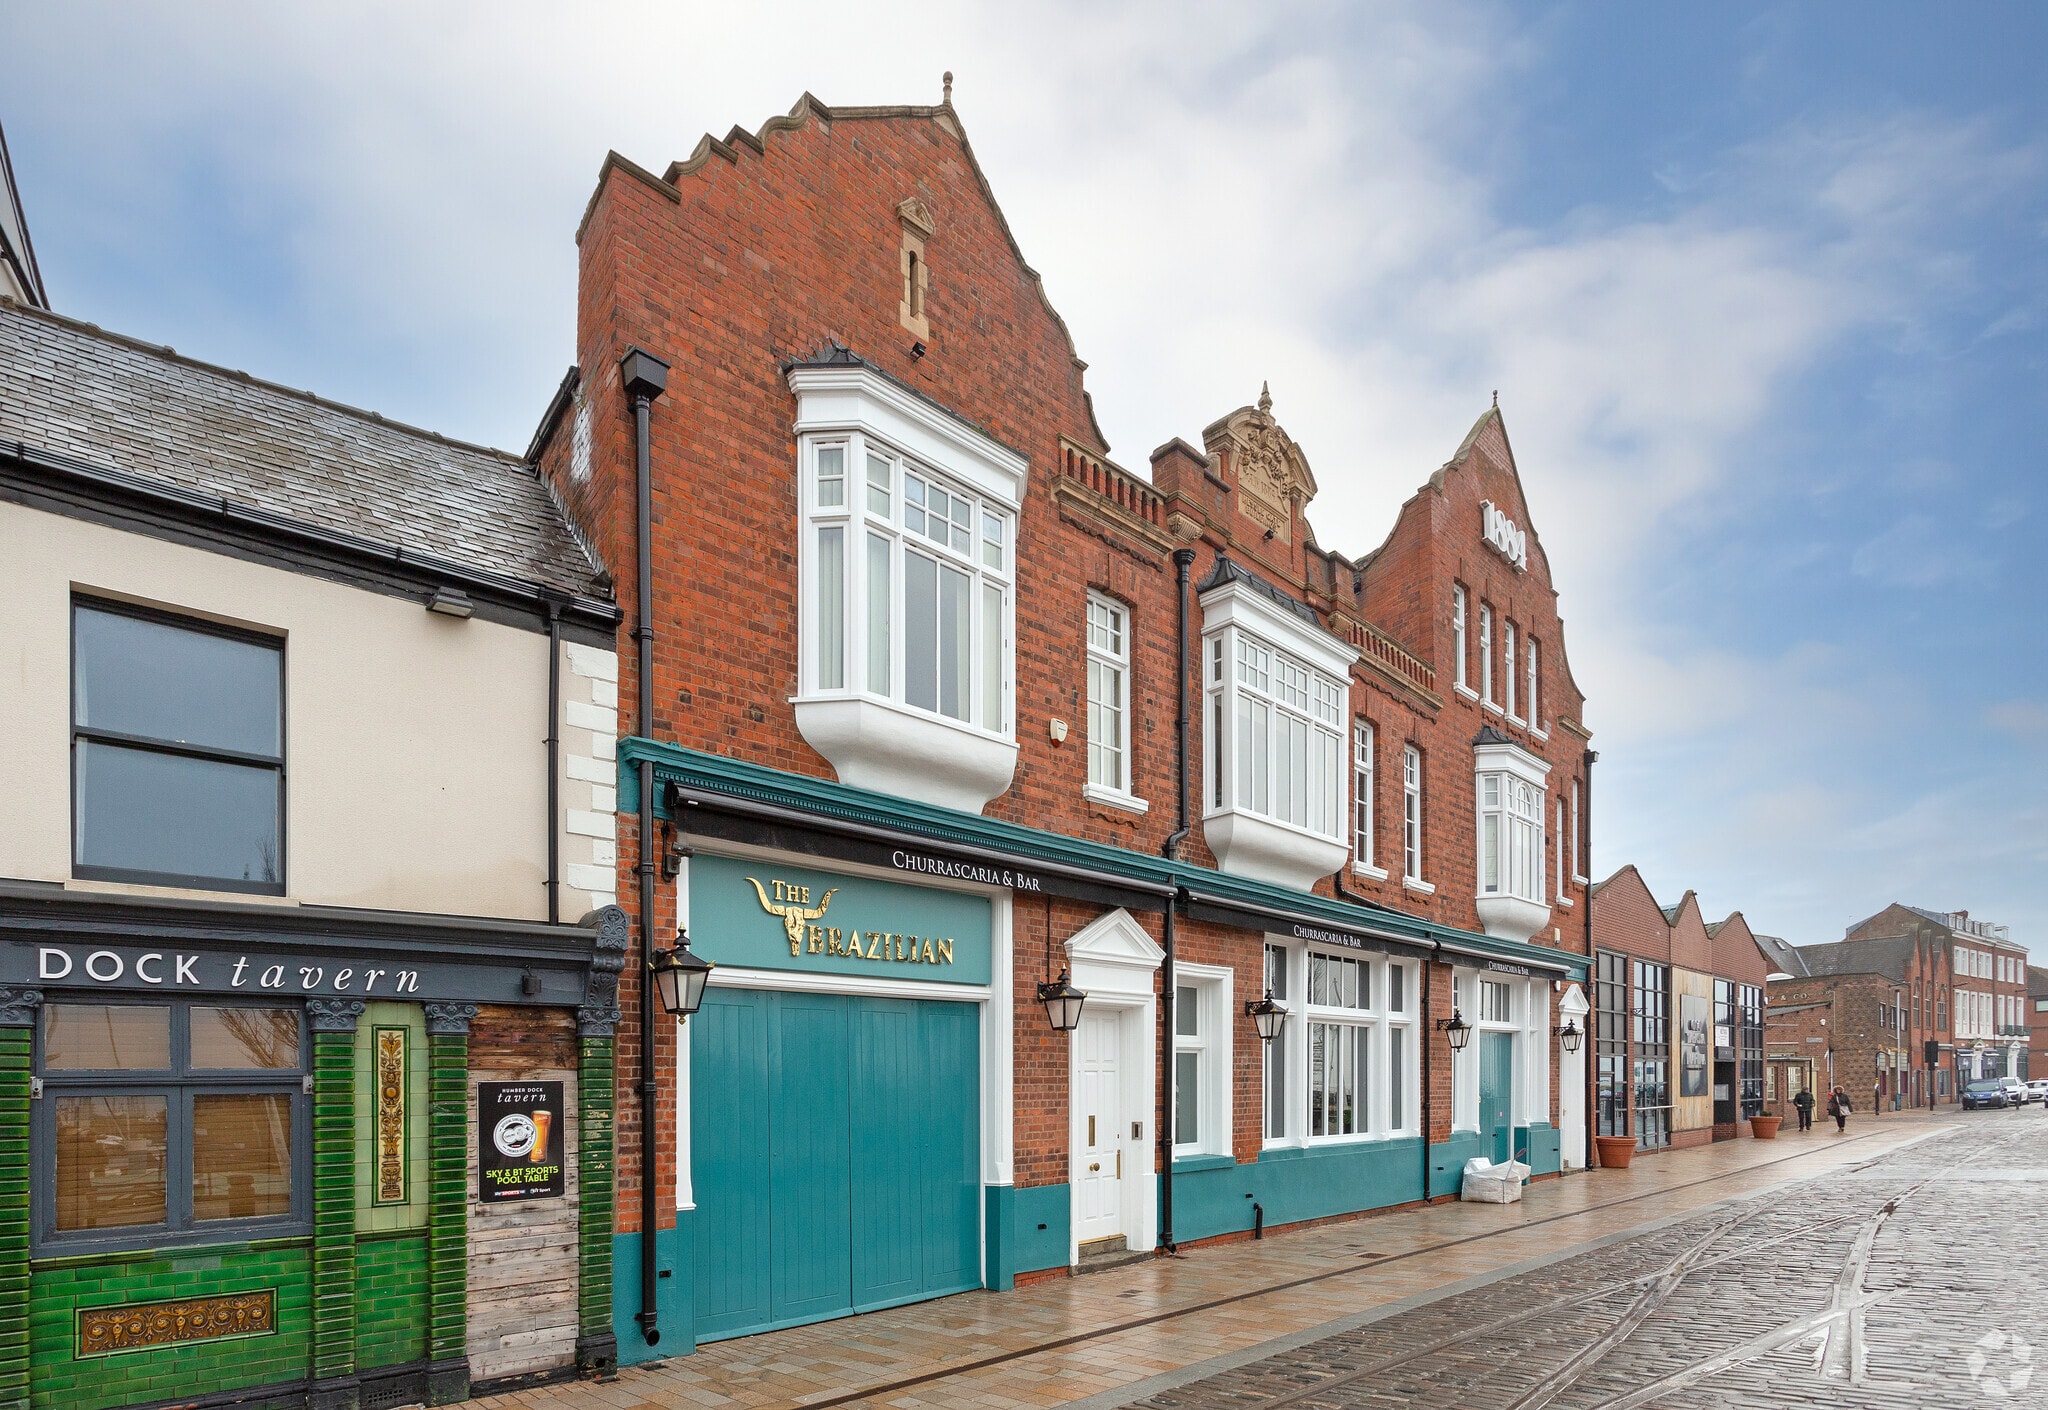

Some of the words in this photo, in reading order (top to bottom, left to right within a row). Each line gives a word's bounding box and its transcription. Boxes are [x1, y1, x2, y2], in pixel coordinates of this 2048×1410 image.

[1480, 499, 1528, 574] 1884
[892, 850, 1000, 885] CHURRASCARIA
[1002, 870, 1014, 887] &
[1017, 872, 1041, 892] BAR
[771, 879, 810, 904] THE
[807, 924, 955, 965] BRAZILIAN
[1293, 924, 1343, 945] CHURRASCARIA
[1343, 934, 1350, 946] &
[1350, 935, 1362, 948] BAR
[38, 947, 201, 985] DOCK
[230, 956, 421, 993] tavern
[497, 1092, 547, 1103] tavern
[486, 1169, 503, 1179] SKY
[504, 1168, 511, 1177] &
[513, 1168, 524, 1177] BT
[525, 1165, 559, 1176] SPORTS
[497, 1175, 523, 1185] POOL
[524, 1173, 549, 1183] TABLE
